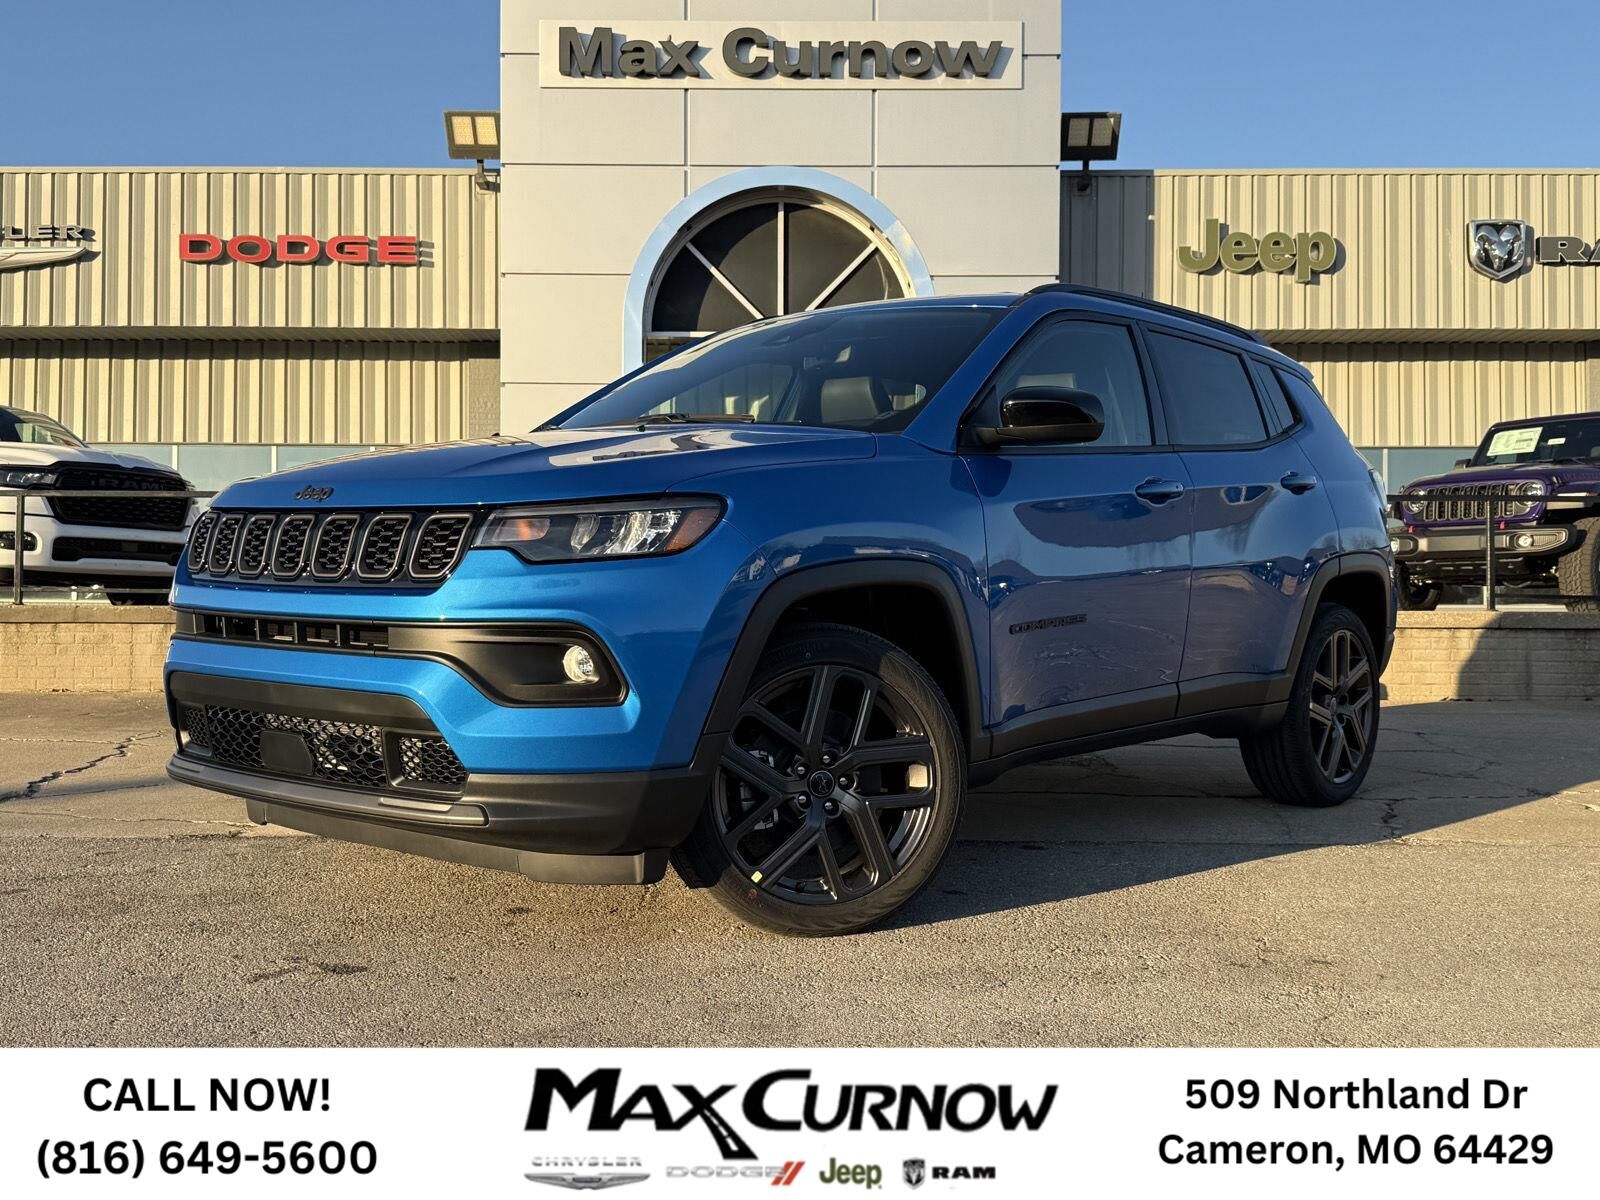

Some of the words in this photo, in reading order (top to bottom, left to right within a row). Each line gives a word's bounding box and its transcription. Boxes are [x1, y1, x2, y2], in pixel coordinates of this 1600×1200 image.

[558, 26, 701, 78] Max
[722, 26, 1003, 78] Curnow
[0, 225, 83, 240] LER
[179, 233, 420, 265] DODGE
[1177, 218, 1337, 283] Jeep
[1537, 236, 1600, 264] R
